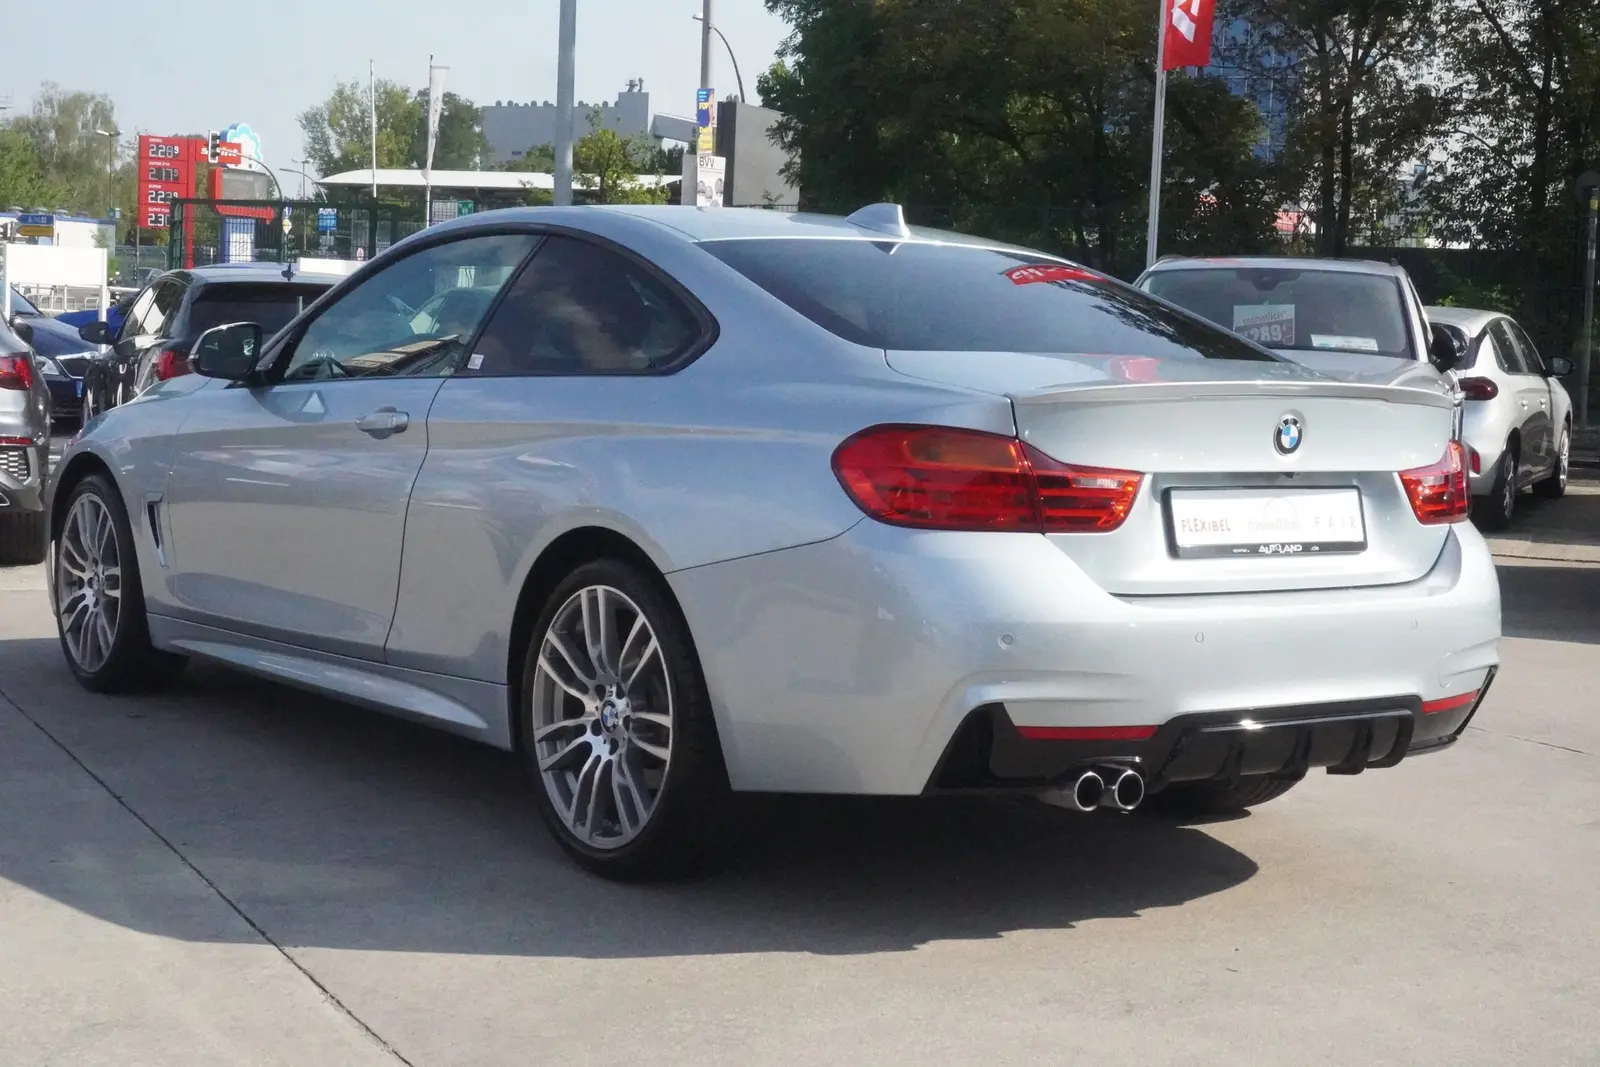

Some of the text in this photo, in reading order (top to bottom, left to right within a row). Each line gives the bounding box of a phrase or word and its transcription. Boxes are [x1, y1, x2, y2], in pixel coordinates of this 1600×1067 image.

[699, 156, 715, 168] BVV
[1181, 518, 1232, 533] FLEXIBEL
[1258, 543, 1303, 554] AUTOLAND
